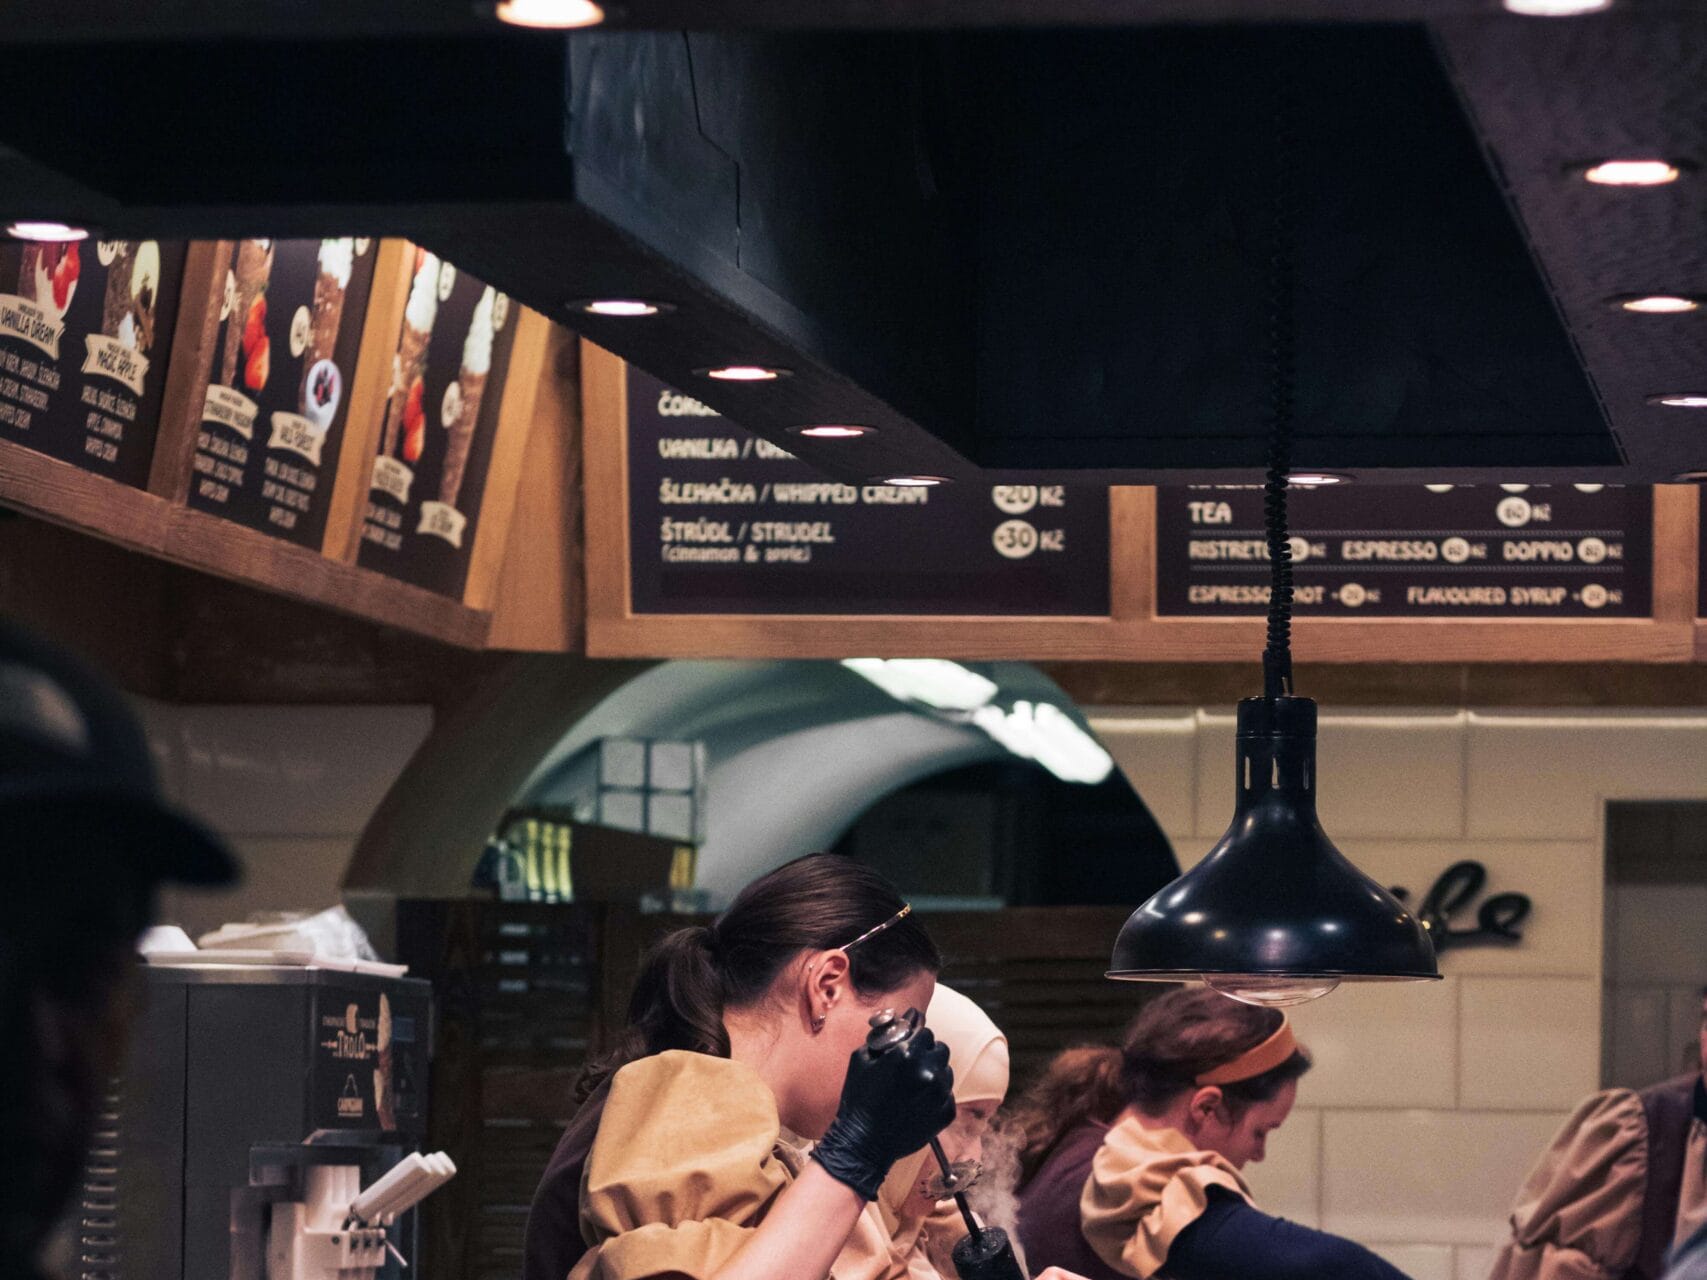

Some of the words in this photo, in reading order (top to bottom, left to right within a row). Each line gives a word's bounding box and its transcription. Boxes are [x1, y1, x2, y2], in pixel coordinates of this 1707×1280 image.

[659, 438, 739, 458] VANILKA
[659, 478, 756, 503] ŠLEHAČKA
[772, 484, 858, 503] WHIPPED
[1188, 502, 1232, 523] TEA
[751, 522, 836, 542] STRUDEL
[1342, 541, 1438, 560] ESPRESSO
[1503, 541, 1573, 561] DOPPIO
[1407, 586, 1506, 605] FLAVOURED
[1510, 586, 1567, 605] SYRUP
